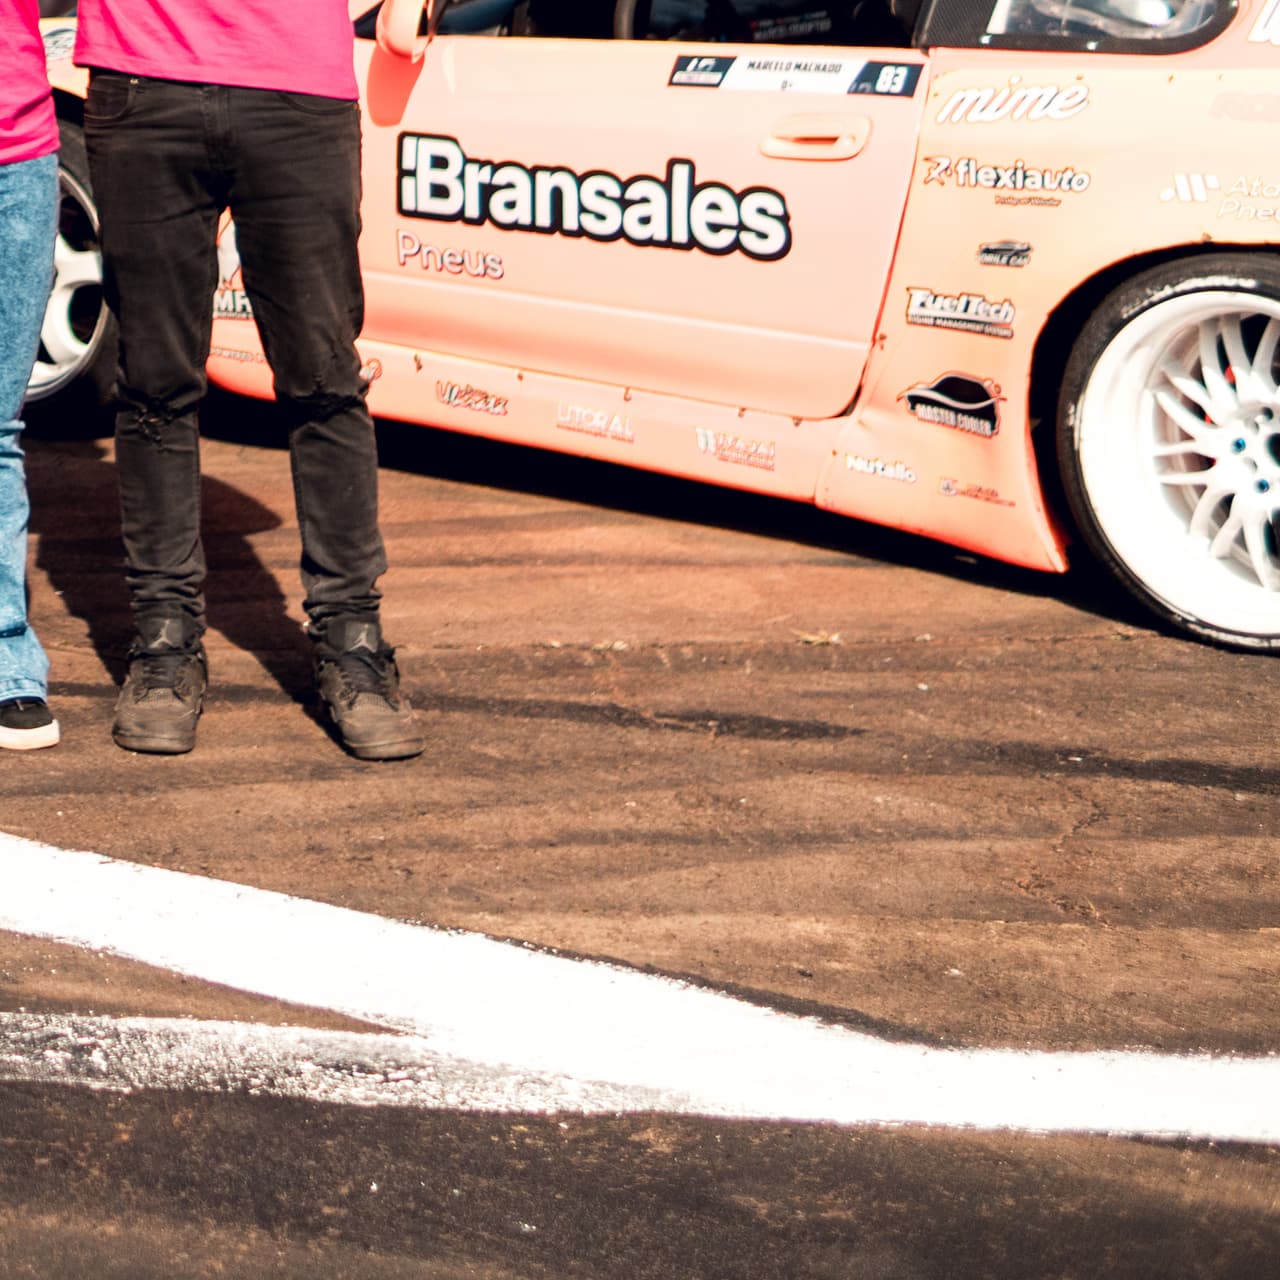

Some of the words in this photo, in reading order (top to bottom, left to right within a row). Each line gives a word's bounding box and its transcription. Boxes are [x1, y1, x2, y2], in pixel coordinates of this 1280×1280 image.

[747, 60, 791, 72] MARCELO
[793, 61, 842, 74] MACHADO
[955, 157, 1091, 192] flexiauto
[399, 133, 790, 260] Bransales
[396, 229, 506, 281] Pneus
[908, 287, 1016, 324] FuelTech
[916, 403, 957, 429] MASTER
[957, 413, 992, 437] COOLER
